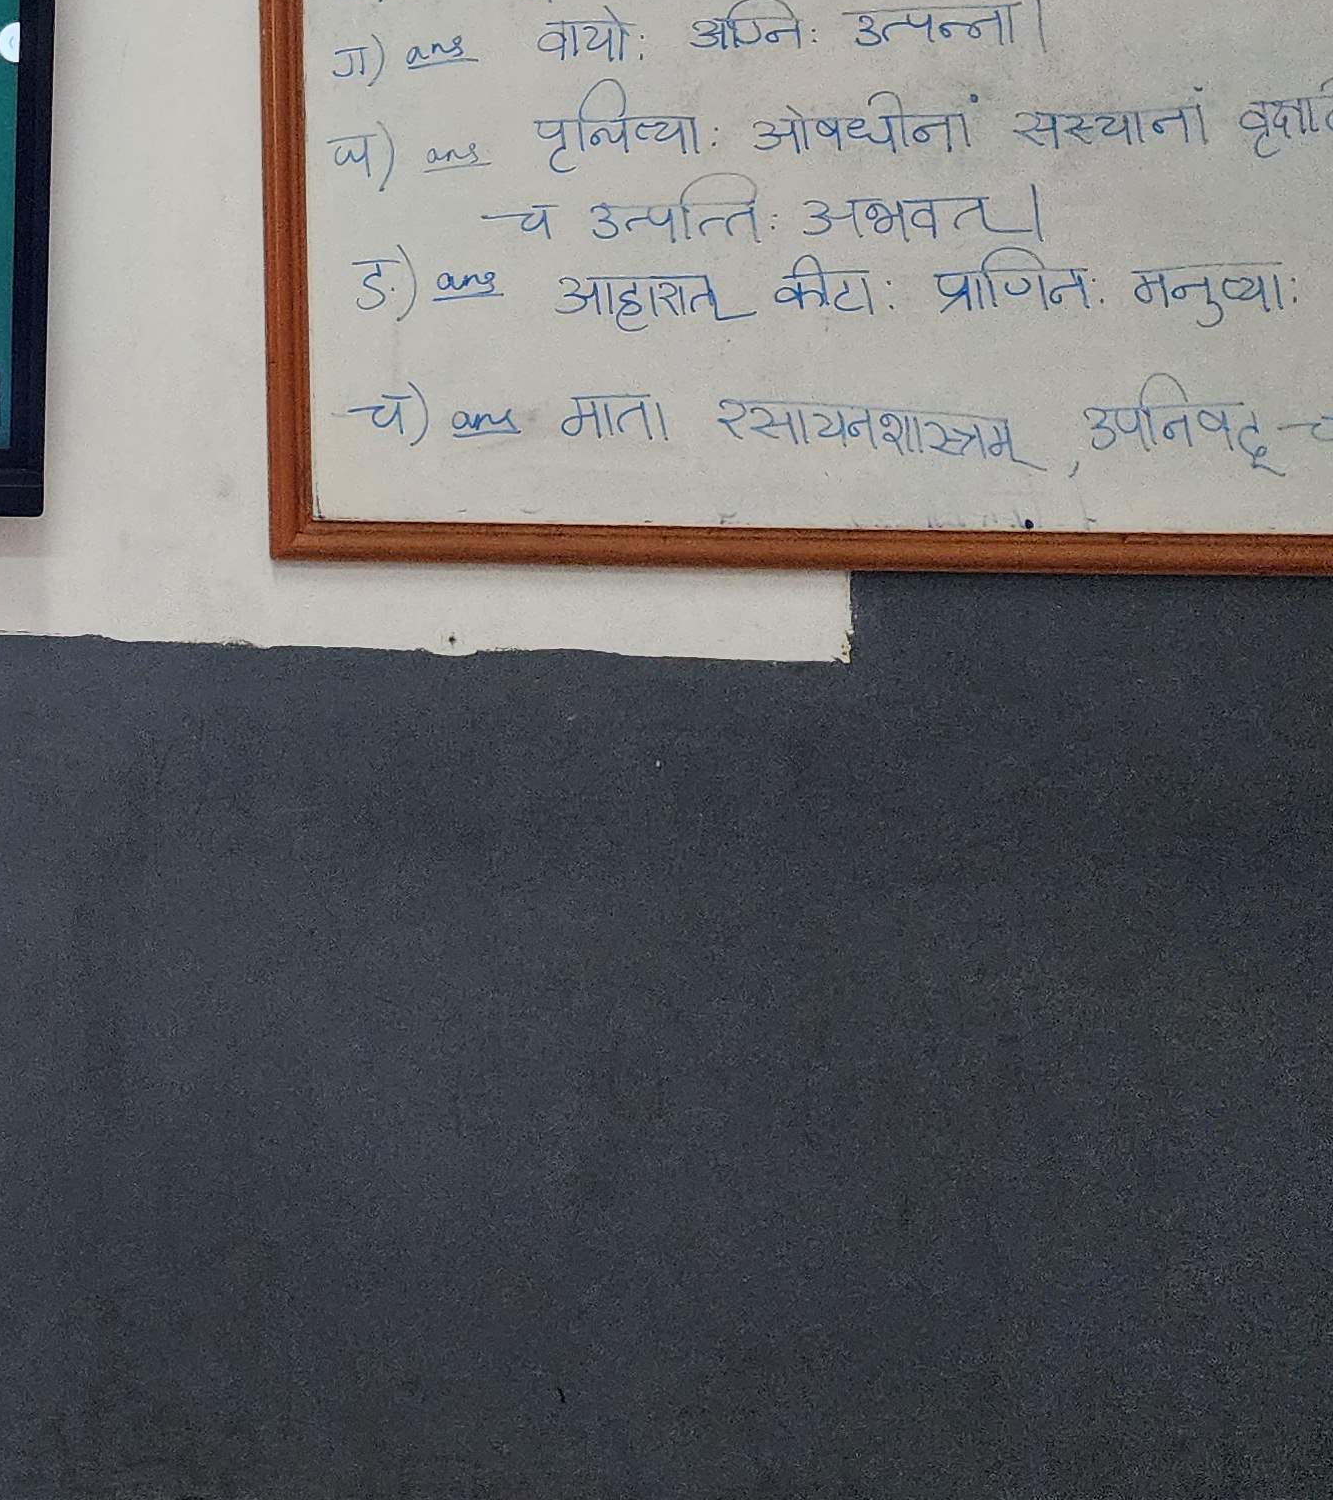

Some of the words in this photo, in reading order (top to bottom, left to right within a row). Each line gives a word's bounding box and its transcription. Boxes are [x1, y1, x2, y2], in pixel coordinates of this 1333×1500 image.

[406, 35, 464, 65] ans
[427, 142, 479, 164] ans
[436, 272, 497, 297] ans
[452, 408, 518, 433] ans
